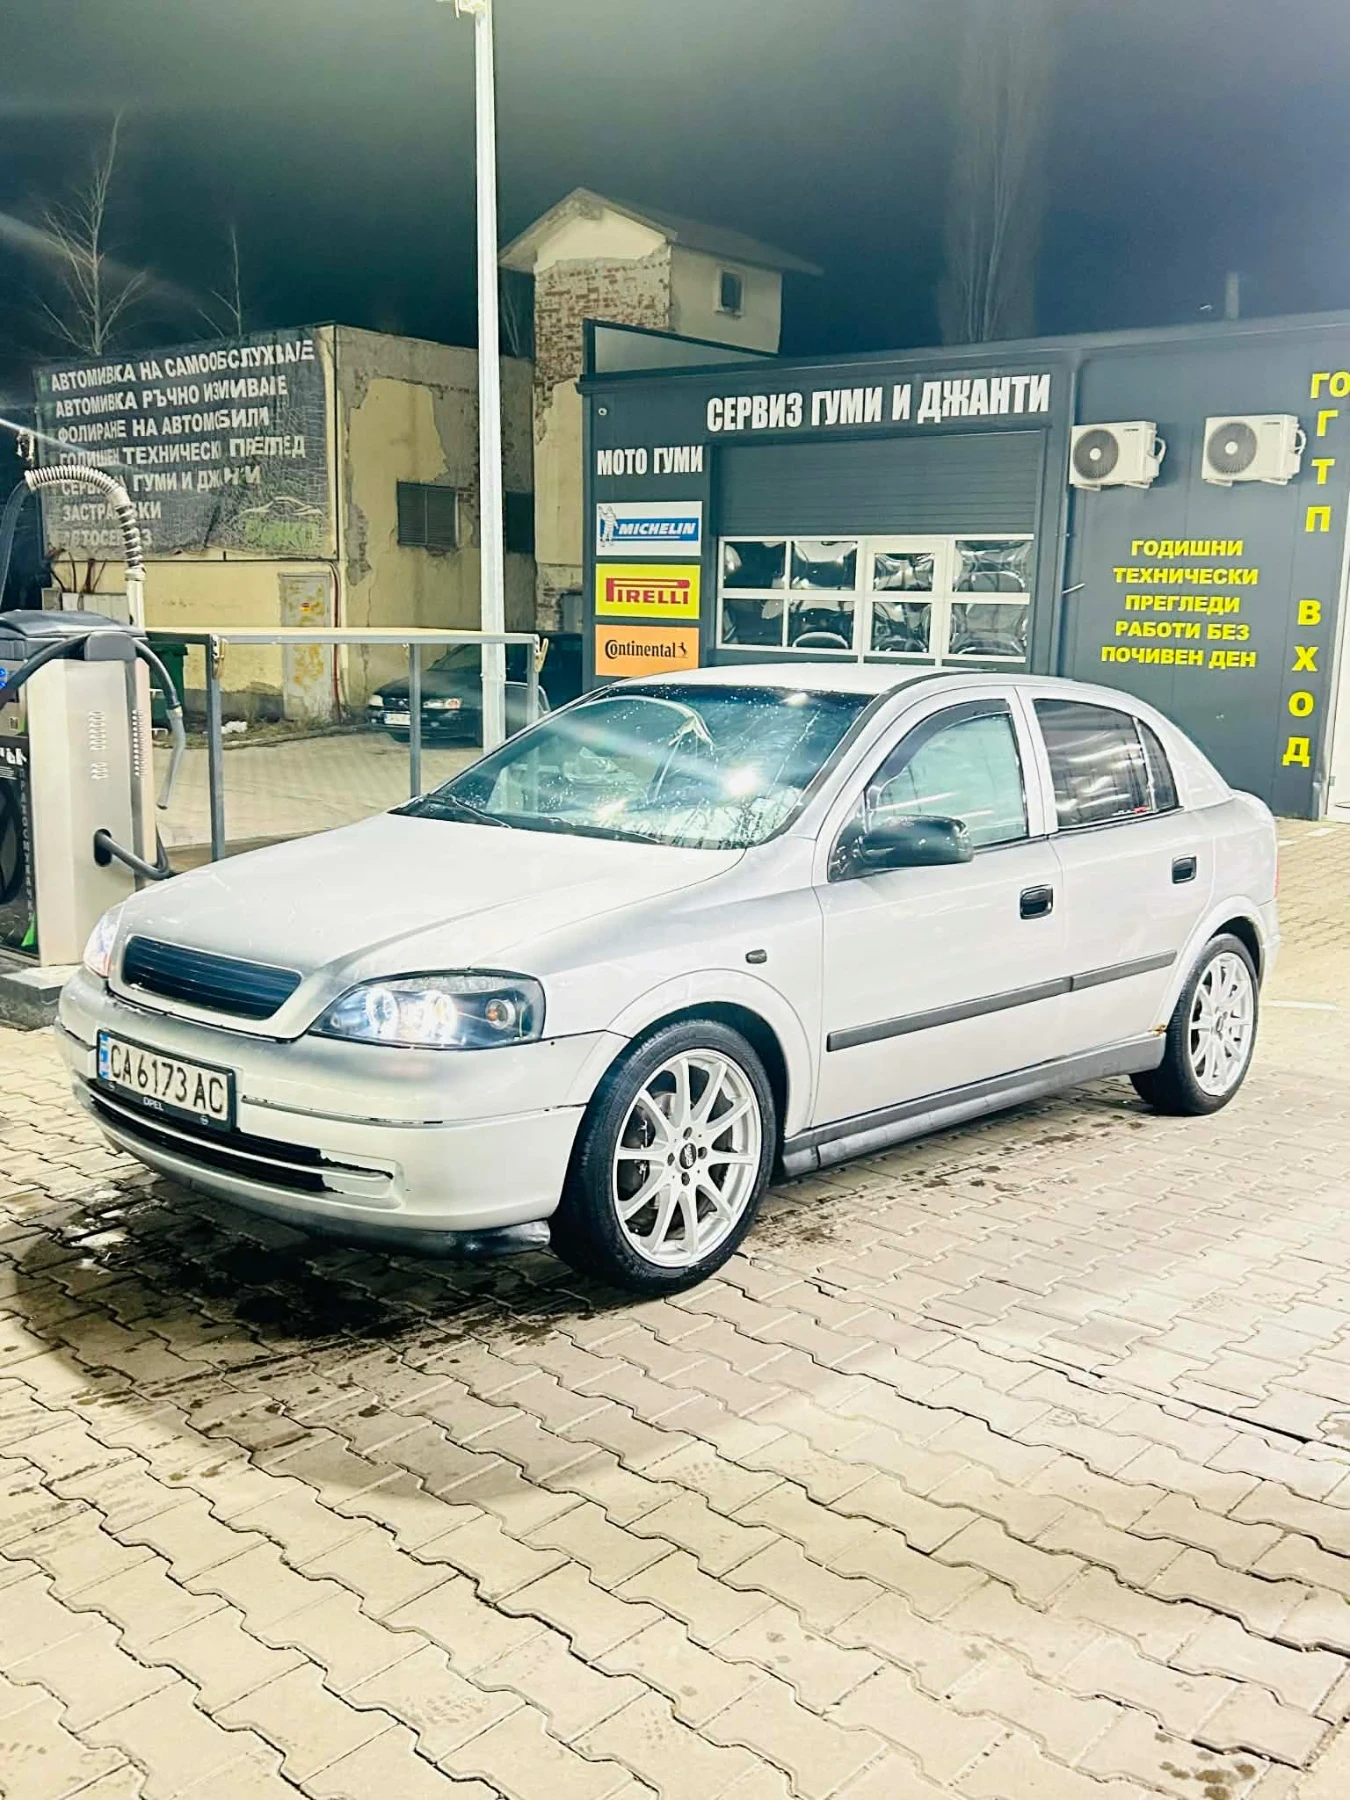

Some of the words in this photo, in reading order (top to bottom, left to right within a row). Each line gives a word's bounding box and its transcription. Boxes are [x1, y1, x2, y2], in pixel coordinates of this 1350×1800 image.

[51, 364, 136, 391] АВТОМИВКА
[140, 360, 163, 380] НА
[56, 391, 138, 418] АВТОМИВКА
[142, 385, 200, 409] РЪЧНО
[707, 392, 803, 432] СЕРВИЗ
[811, 386, 883, 426] ГУМИ
[892, 384, 910, 421] И
[917, 374, 1051, 424] ДЖАНТИ
[58, 420, 127, 443] ФОЛИРАНЕ
[132, 418, 158, 437] НА
[597, 449, 648, 476] МОТО
[653, 445, 703, 474] ГУМИ
[133, 471, 177, 493] ГУМИ
[182, 470, 193, 491] И
[618, 522, 697, 535] MICHELIN
[1131, 540, 1244, 558] ГОДИШНИ
[1113, 566, 1259, 585] ТЕХНИЧЕСКИ
[606, 578, 690, 604] PIRELLI
[1125, 595, 1240, 614] ПРЕГЛЕДИ
[1115, 621, 1200, 640] РАБОТИ
[1207, 623, 1250, 641] БЕЗ
[605, 639, 676, 659] Continental
[1101, 647, 1203, 667] ПОЧИВЕН
[1208, 650, 1256, 669] ДЕН
